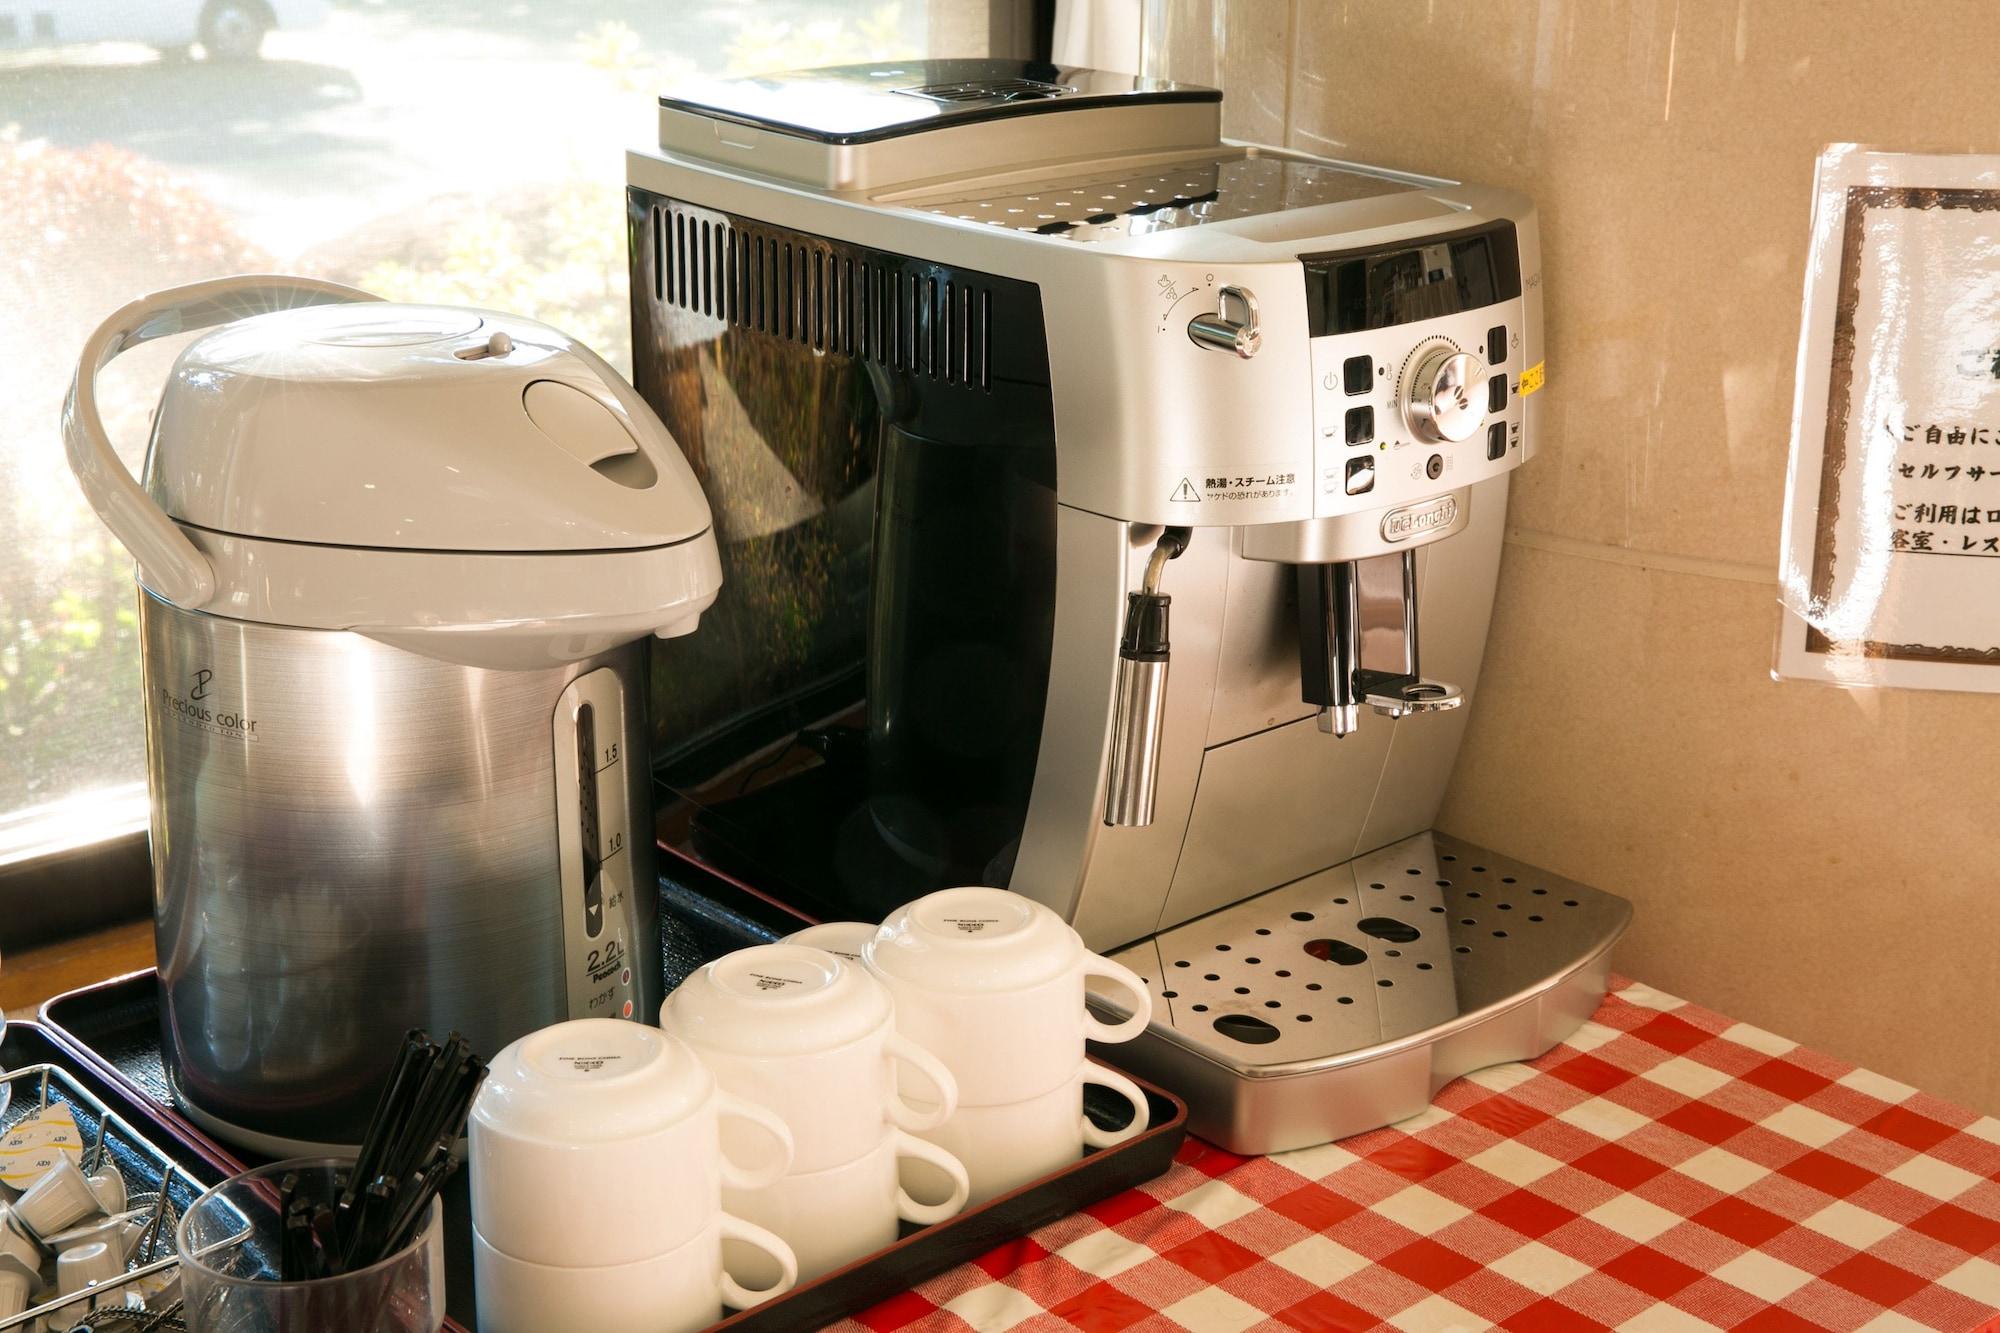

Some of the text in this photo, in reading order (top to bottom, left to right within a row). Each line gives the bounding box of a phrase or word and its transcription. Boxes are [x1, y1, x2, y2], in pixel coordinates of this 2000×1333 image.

[1904, 424, 2000, 445] ご自由に
[1206, 473, 1295, 489] 熱湯・スチーム注意
[162, 688, 212, 722] Precious
[216, 713, 257, 732] color
[605, 743, 618, 763] 1.5
[609, 832, 622, 852] 1.0
[609, 891, 624, 909] 給水
[587, 941, 624, 972] 2.2L
